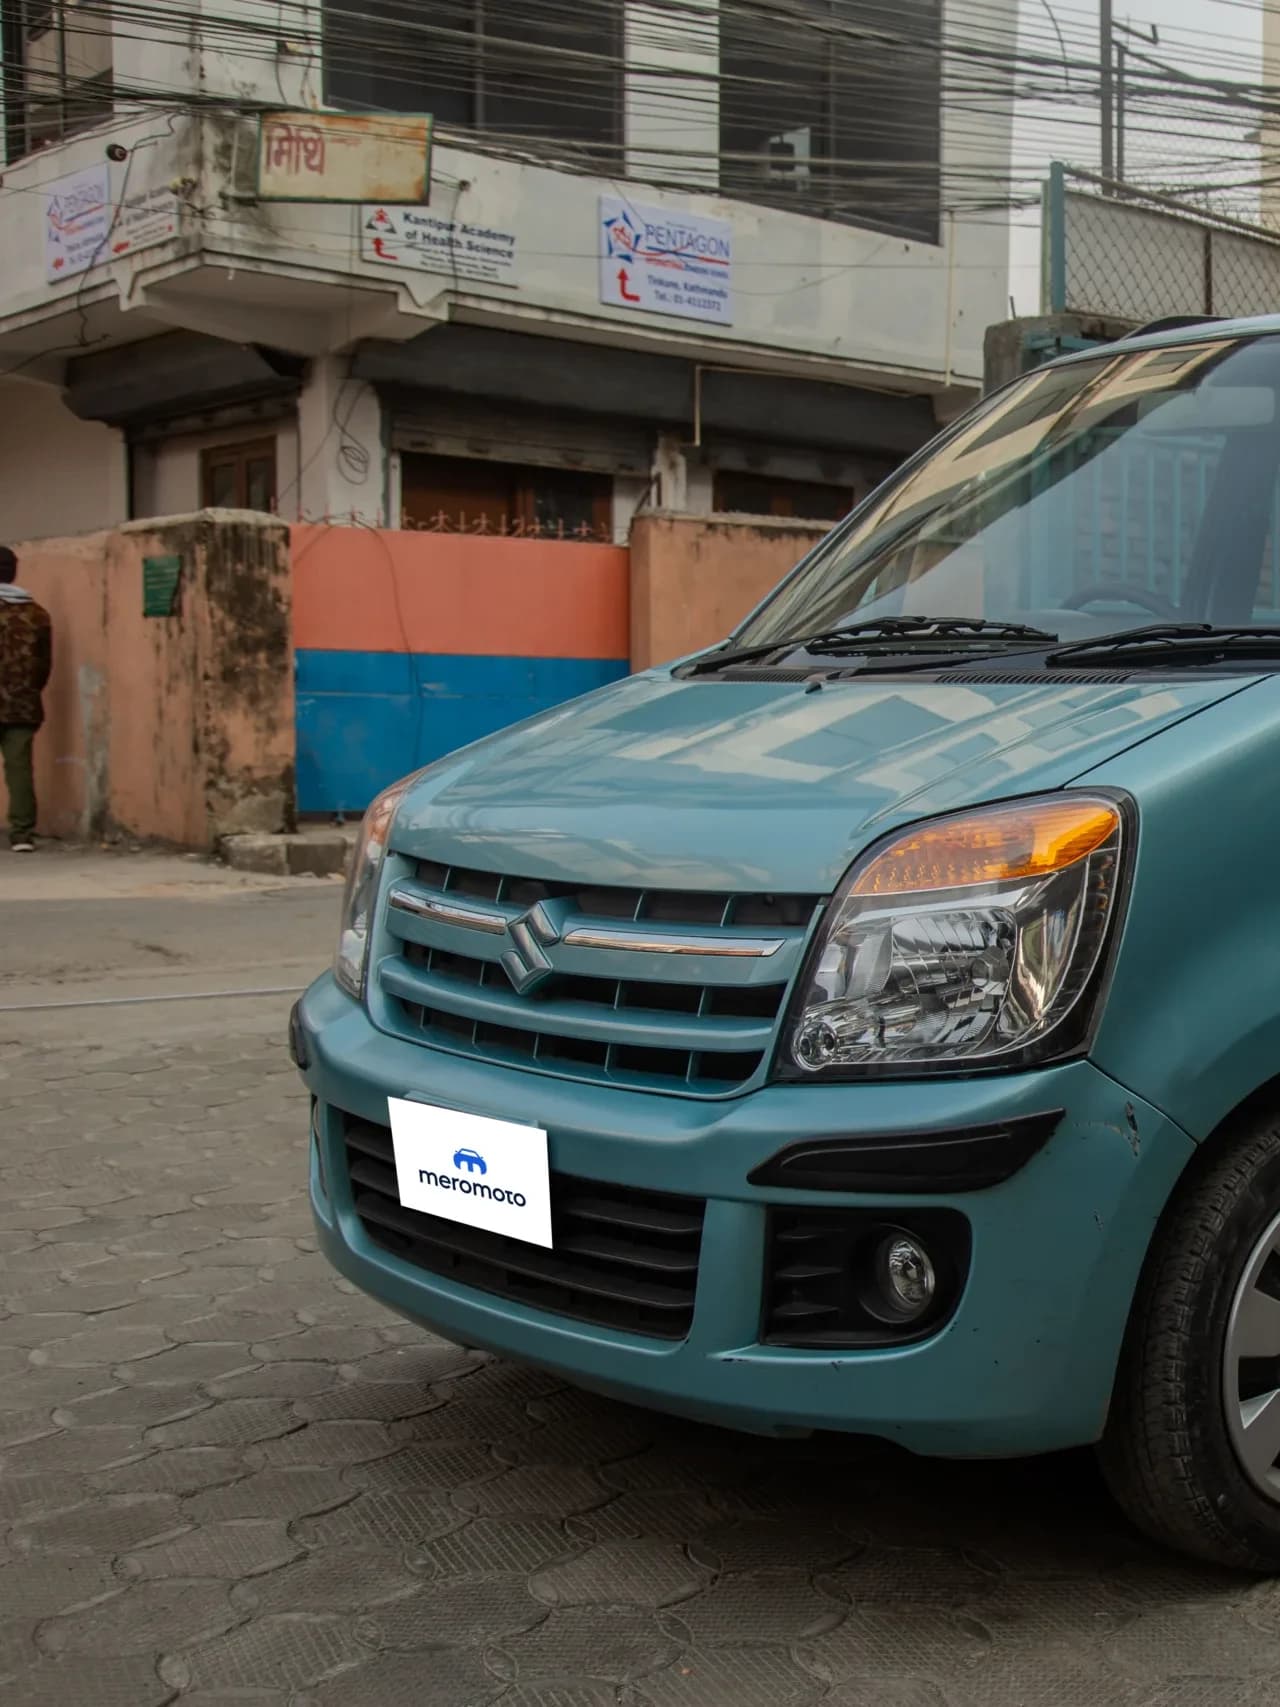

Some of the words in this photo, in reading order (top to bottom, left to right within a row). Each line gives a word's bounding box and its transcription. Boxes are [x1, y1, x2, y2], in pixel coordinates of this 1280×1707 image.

[403, 212, 456, 232] Kantipur
[460, 223, 515, 245] Academy
[405, 230, 417, 240] of
[422, 233, 463, 249] Health
[466, 240, 514, 259] Science
[644, 223, 731, 259] PENTAGON
